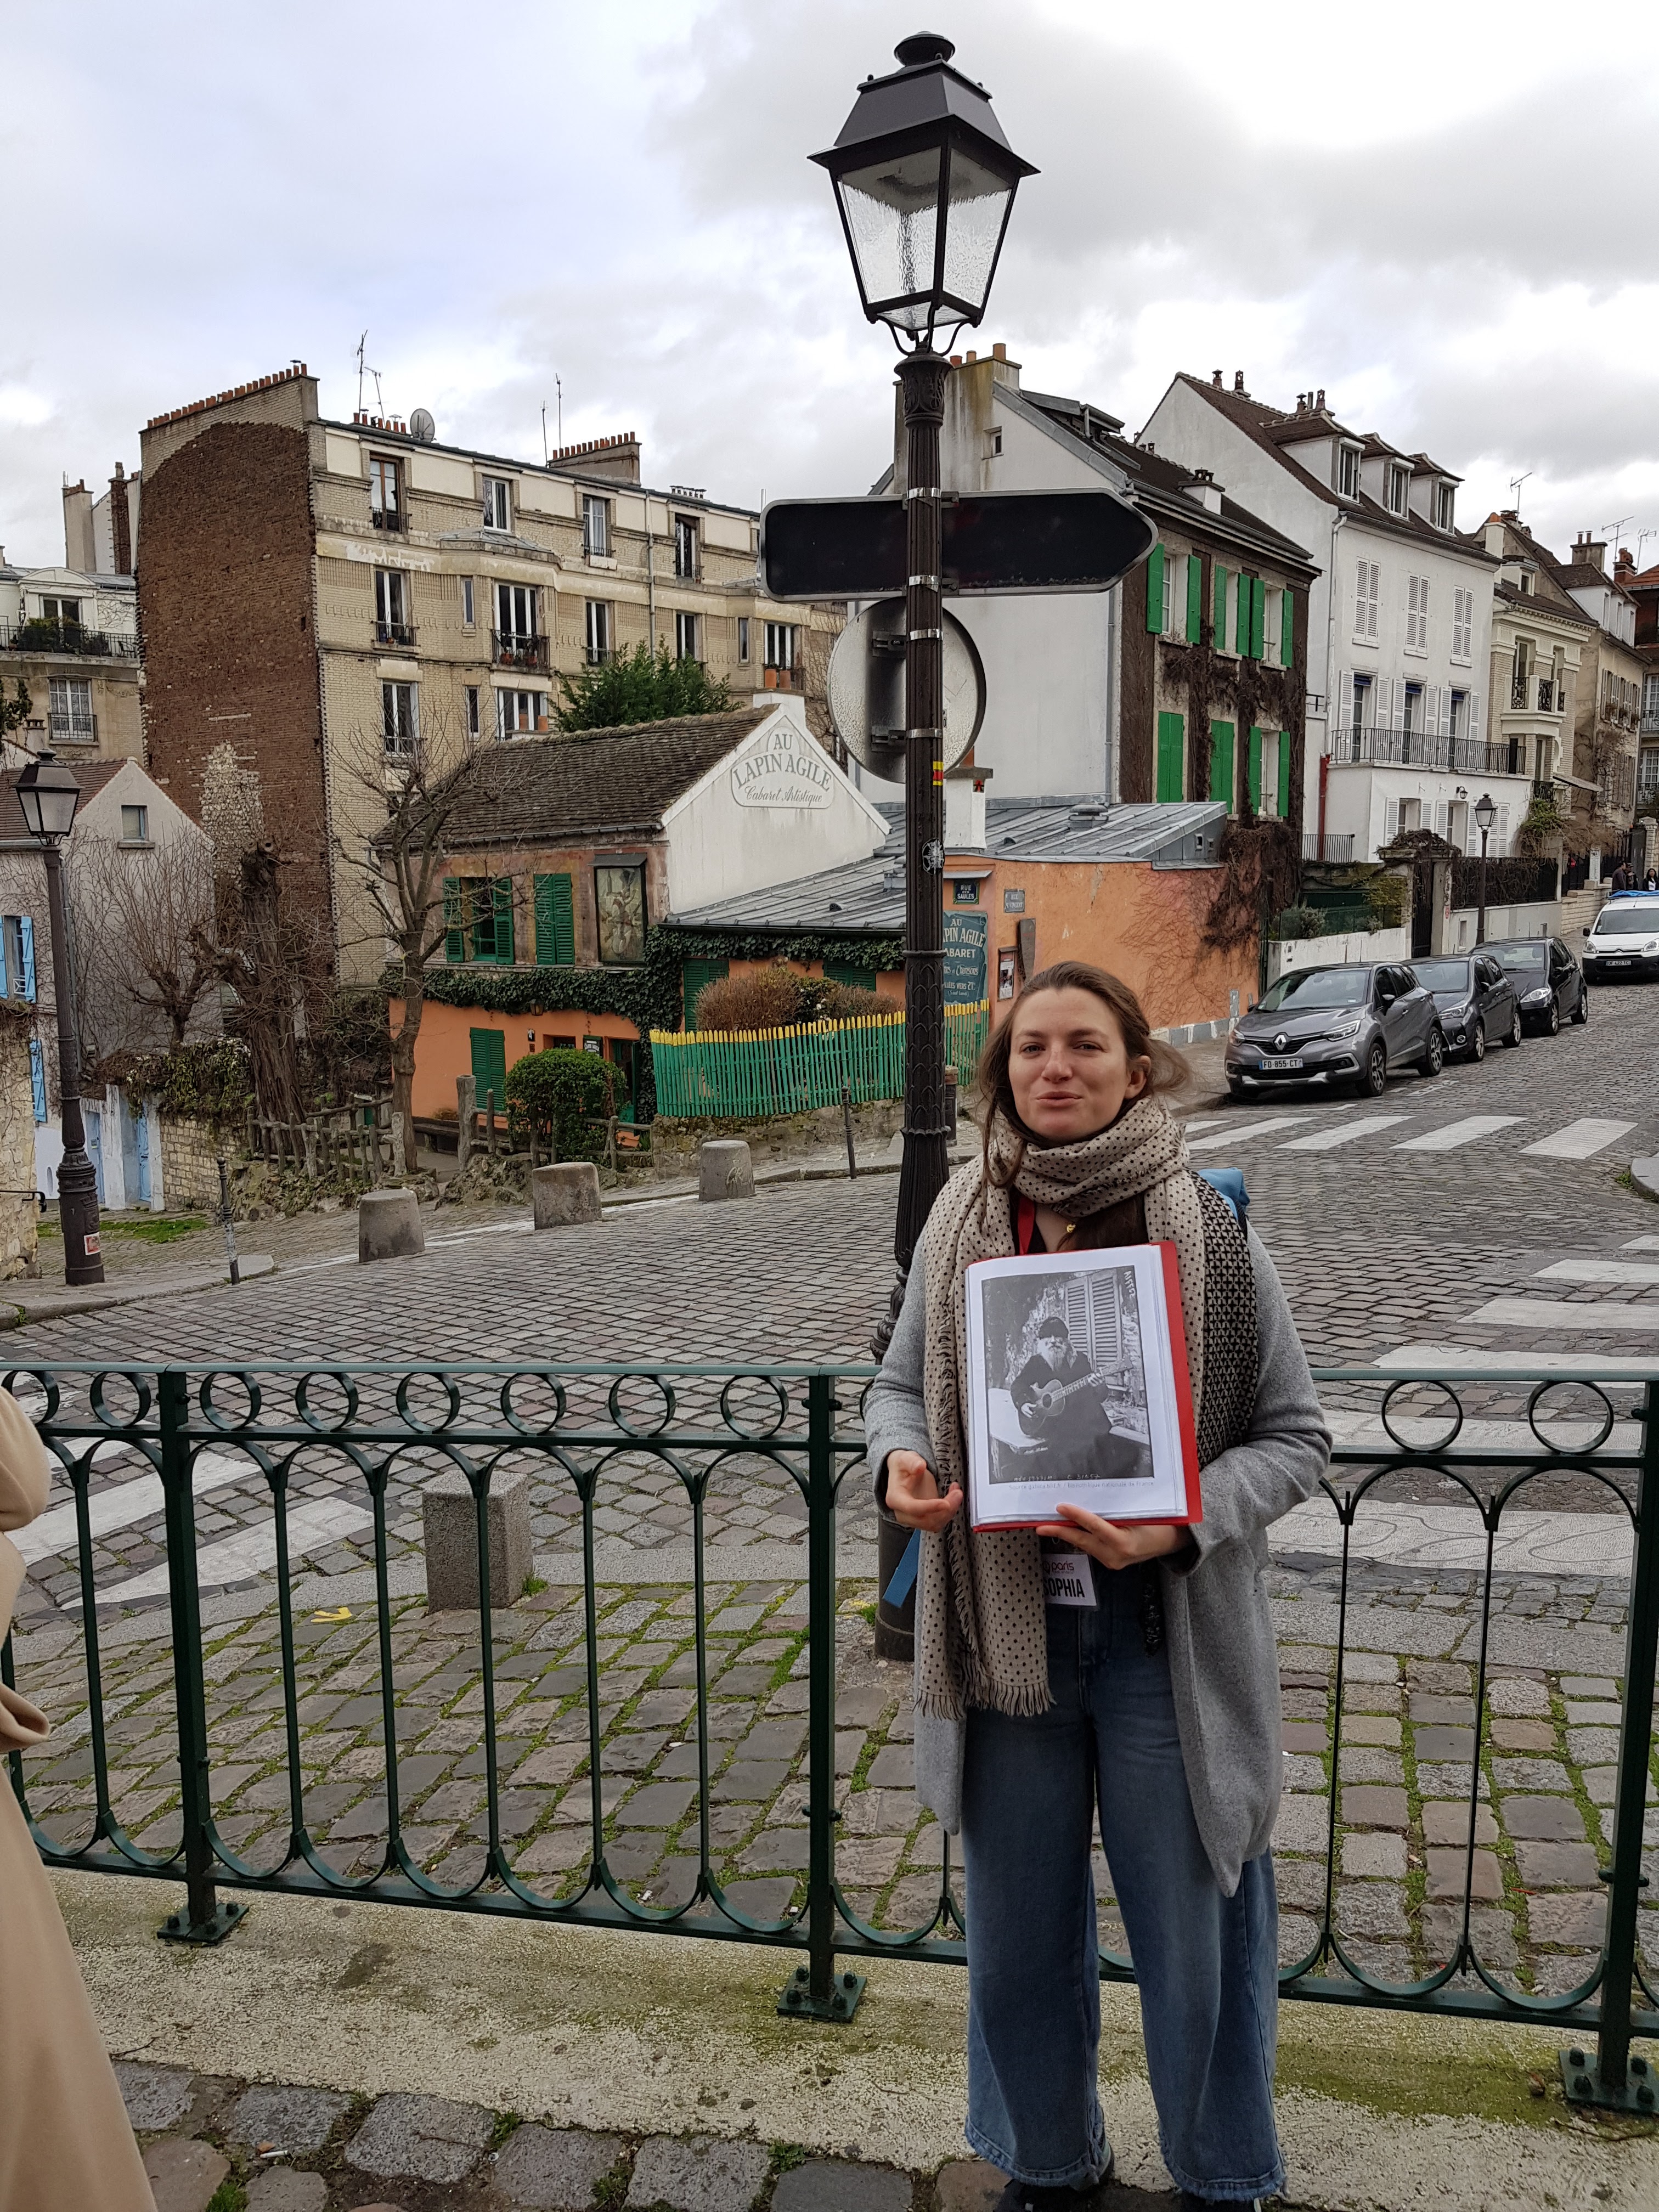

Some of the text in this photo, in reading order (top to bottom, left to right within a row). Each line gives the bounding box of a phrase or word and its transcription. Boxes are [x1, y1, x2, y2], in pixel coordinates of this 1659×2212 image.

[774, 733, 793, 751] AU
[733, 753, 832, 792] LAPIN AGILE
[744, 786, 822, 807] Cabaret Artistique
[943, 927, 985, 947] PIN AGILE
[944, 948, 975, 958] ABARET
[1051, 1560, 1074, 1572] paris
